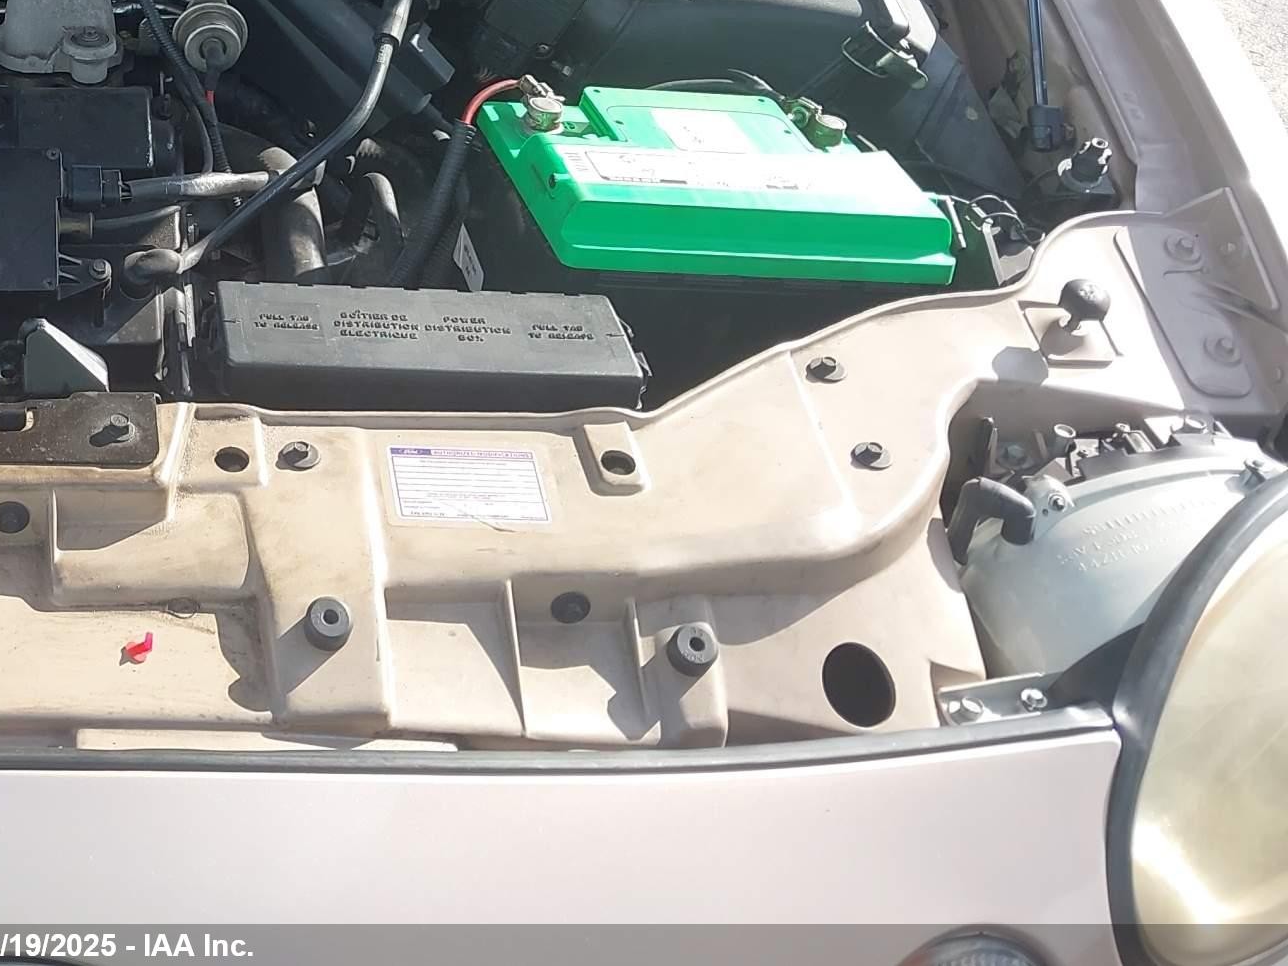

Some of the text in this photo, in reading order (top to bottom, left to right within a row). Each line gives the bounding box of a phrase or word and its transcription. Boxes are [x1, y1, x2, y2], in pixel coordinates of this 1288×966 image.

[442, 315, 487, 325] POWER
[333, 320, 420, 332] DISTRIBUTION
[424, 324, 512, 335] DISTRIBUTION
